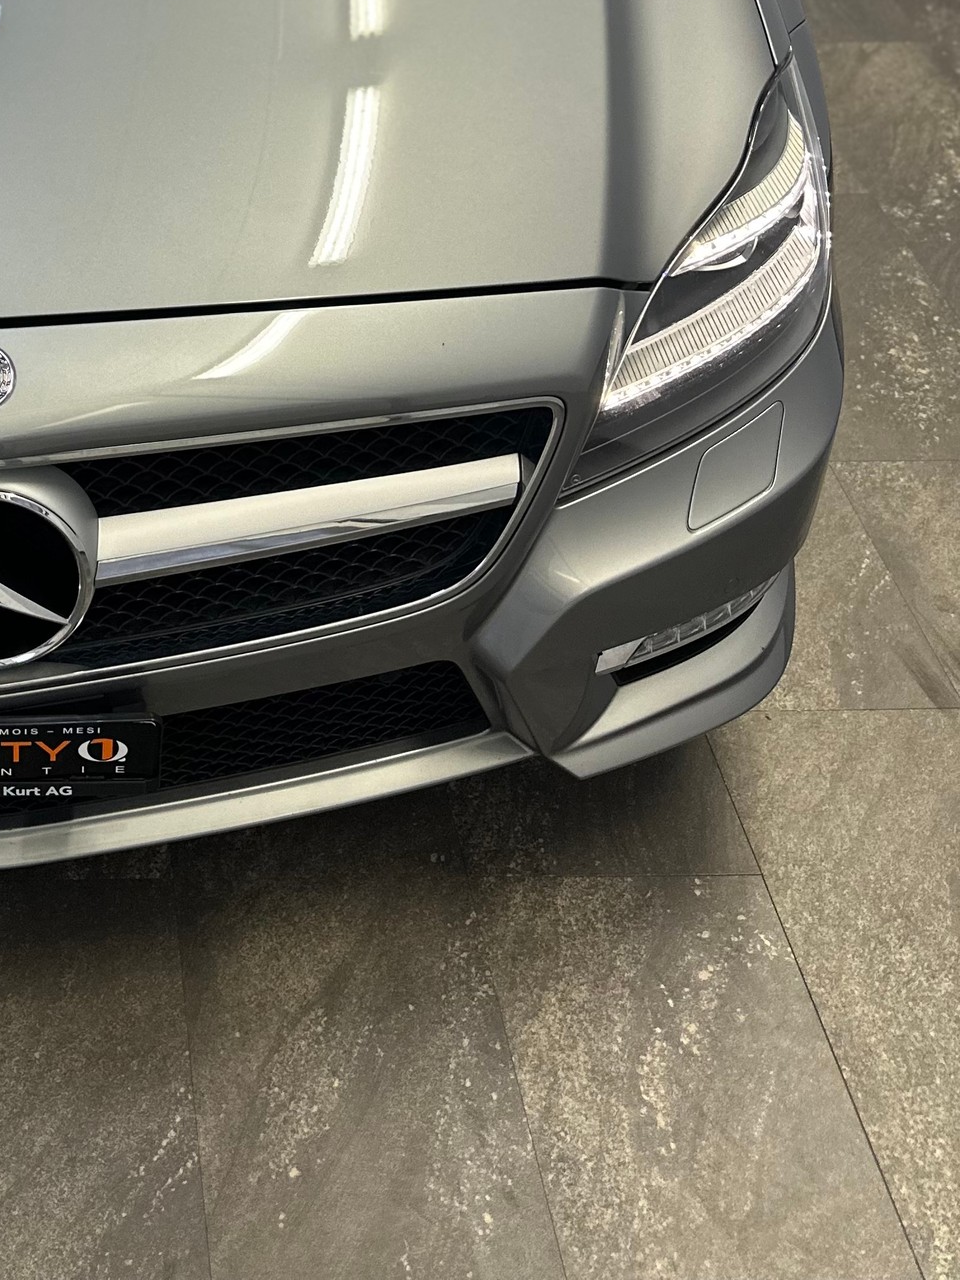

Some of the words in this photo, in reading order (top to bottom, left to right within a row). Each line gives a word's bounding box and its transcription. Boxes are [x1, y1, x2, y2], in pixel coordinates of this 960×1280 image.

[62, 727, 101, 735] MESI
[3, 786, 41, 796] Kurt
[45, 786, 73, 796] AG
